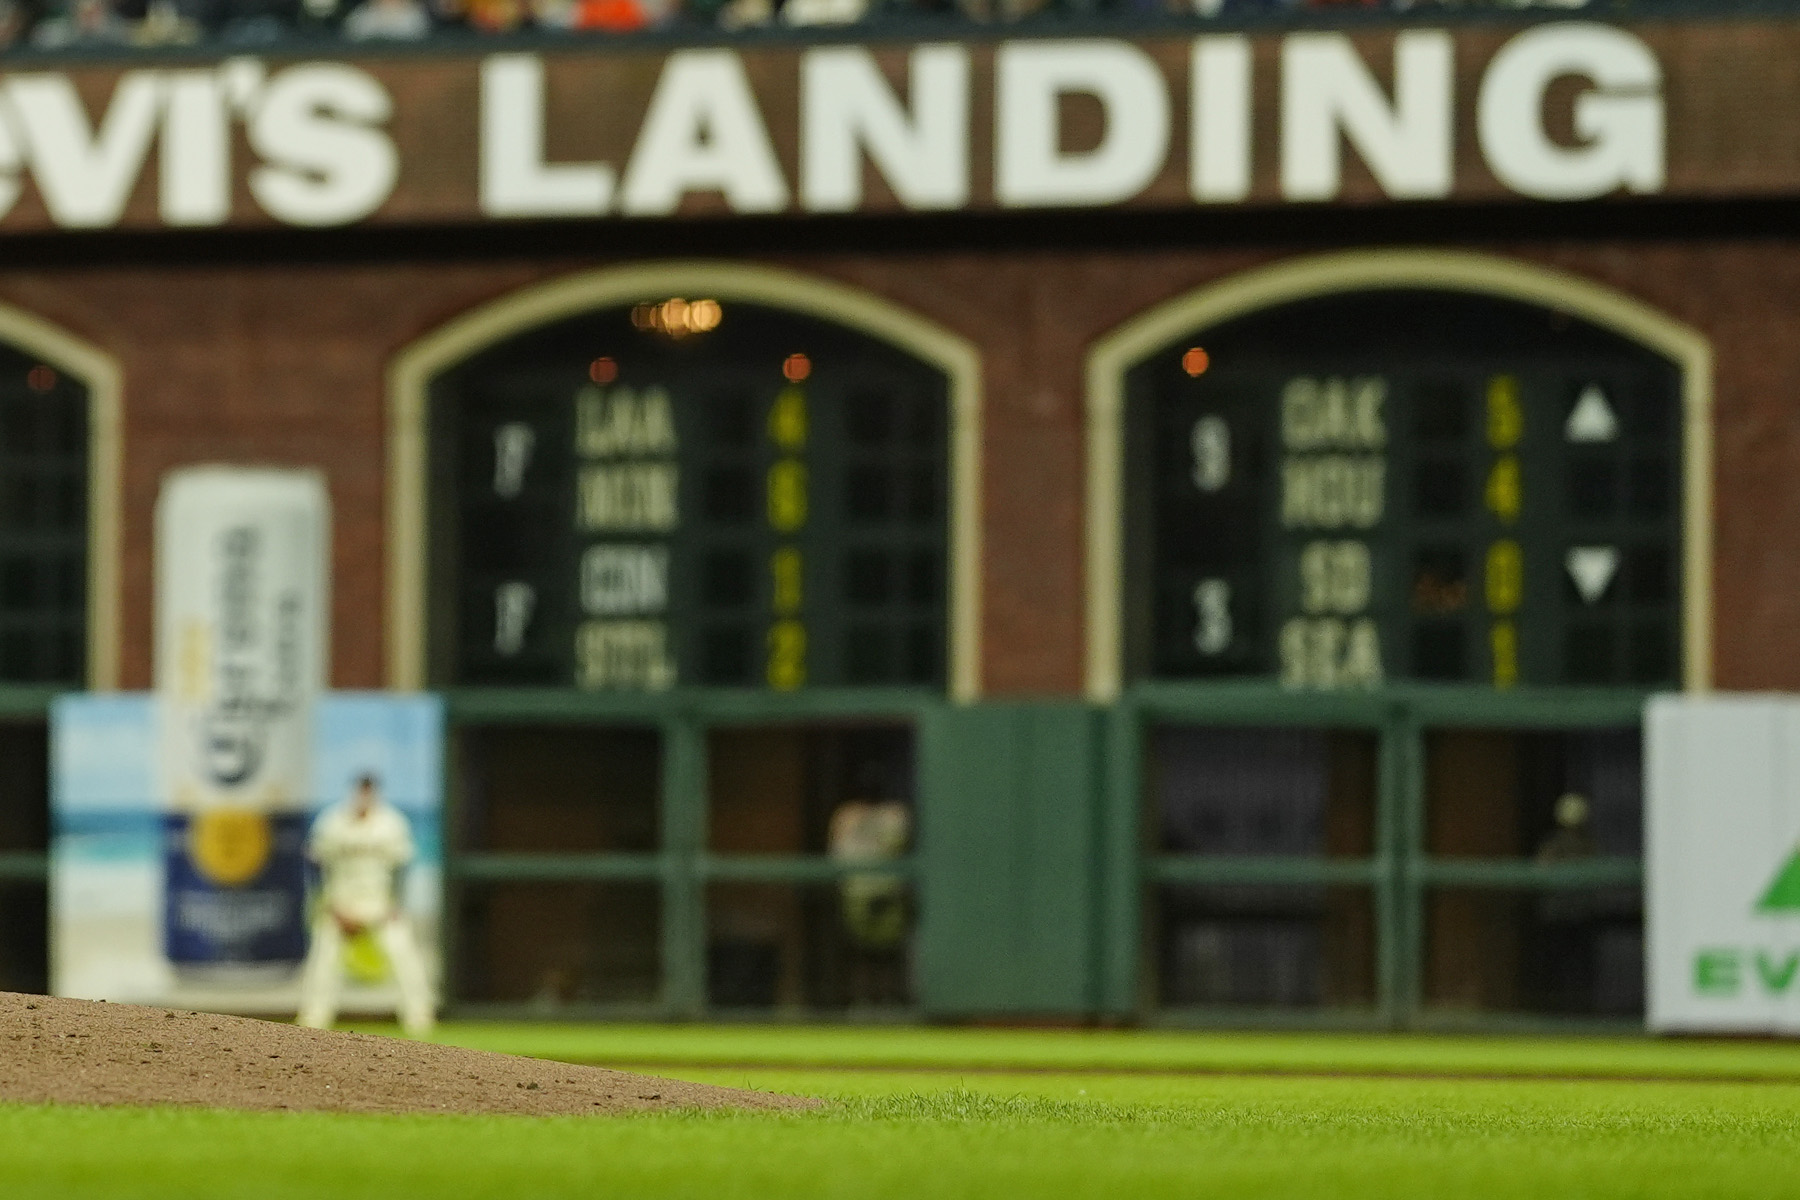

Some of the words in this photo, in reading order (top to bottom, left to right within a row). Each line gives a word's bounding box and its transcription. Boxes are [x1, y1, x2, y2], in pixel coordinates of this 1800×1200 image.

[478, 22, 1666, 216] LANDING
[1280, 377, 1388, 451] OAK
[1278, 619, 1384, 690] SEA
